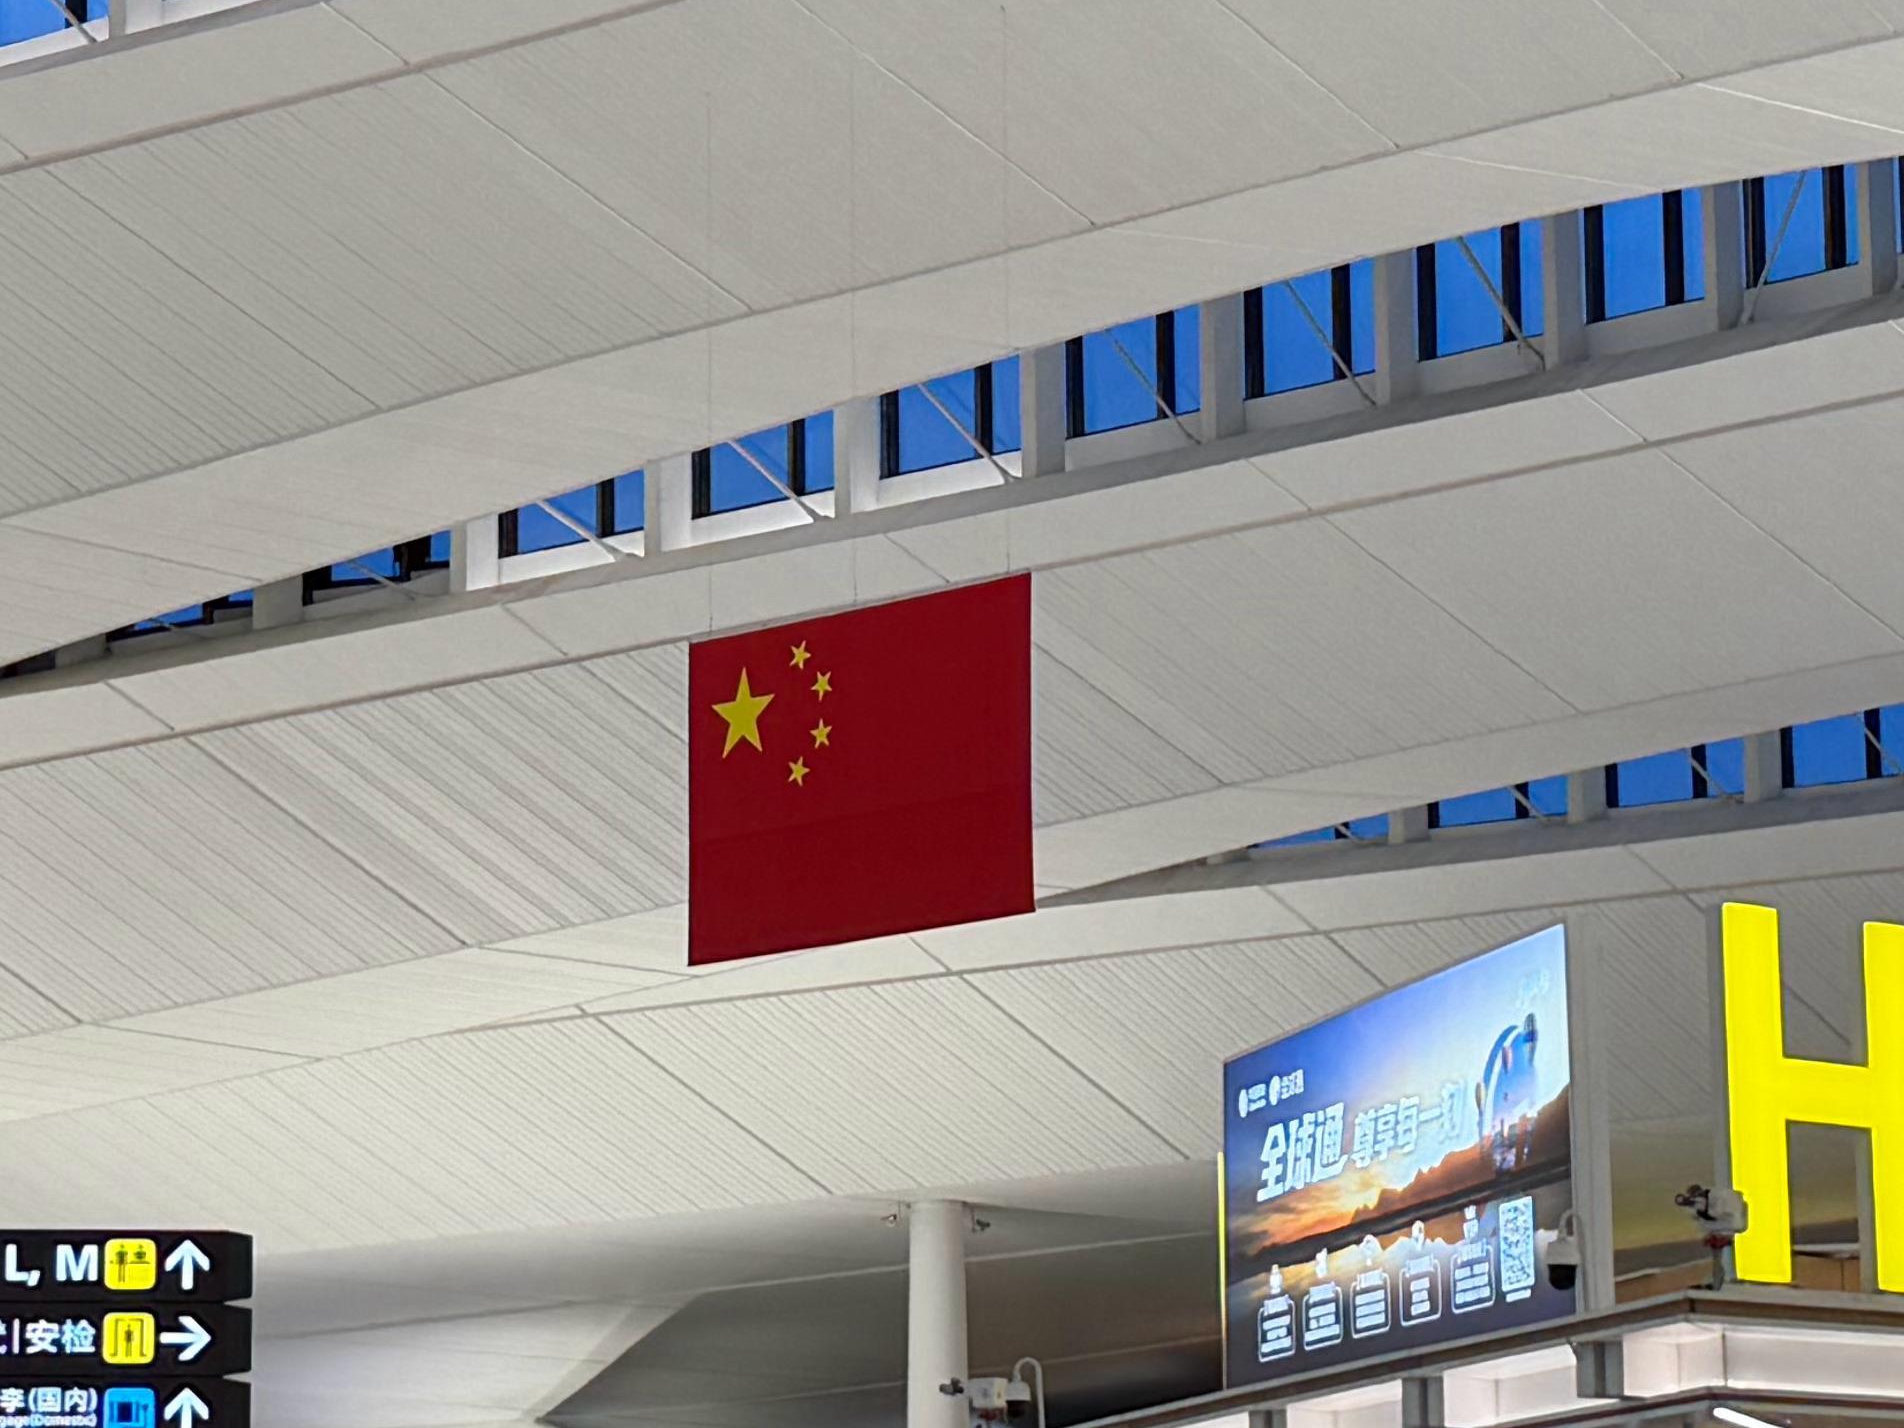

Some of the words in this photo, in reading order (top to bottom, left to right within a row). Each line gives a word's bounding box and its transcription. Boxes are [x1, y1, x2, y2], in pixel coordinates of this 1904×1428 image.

[1256, 1101, 1348, 1203] 全球通
[5, 1243, 41, 1286] L,
[56, 1243, 99, 1281] M
[25, 1319, 96, 1354] 安检
